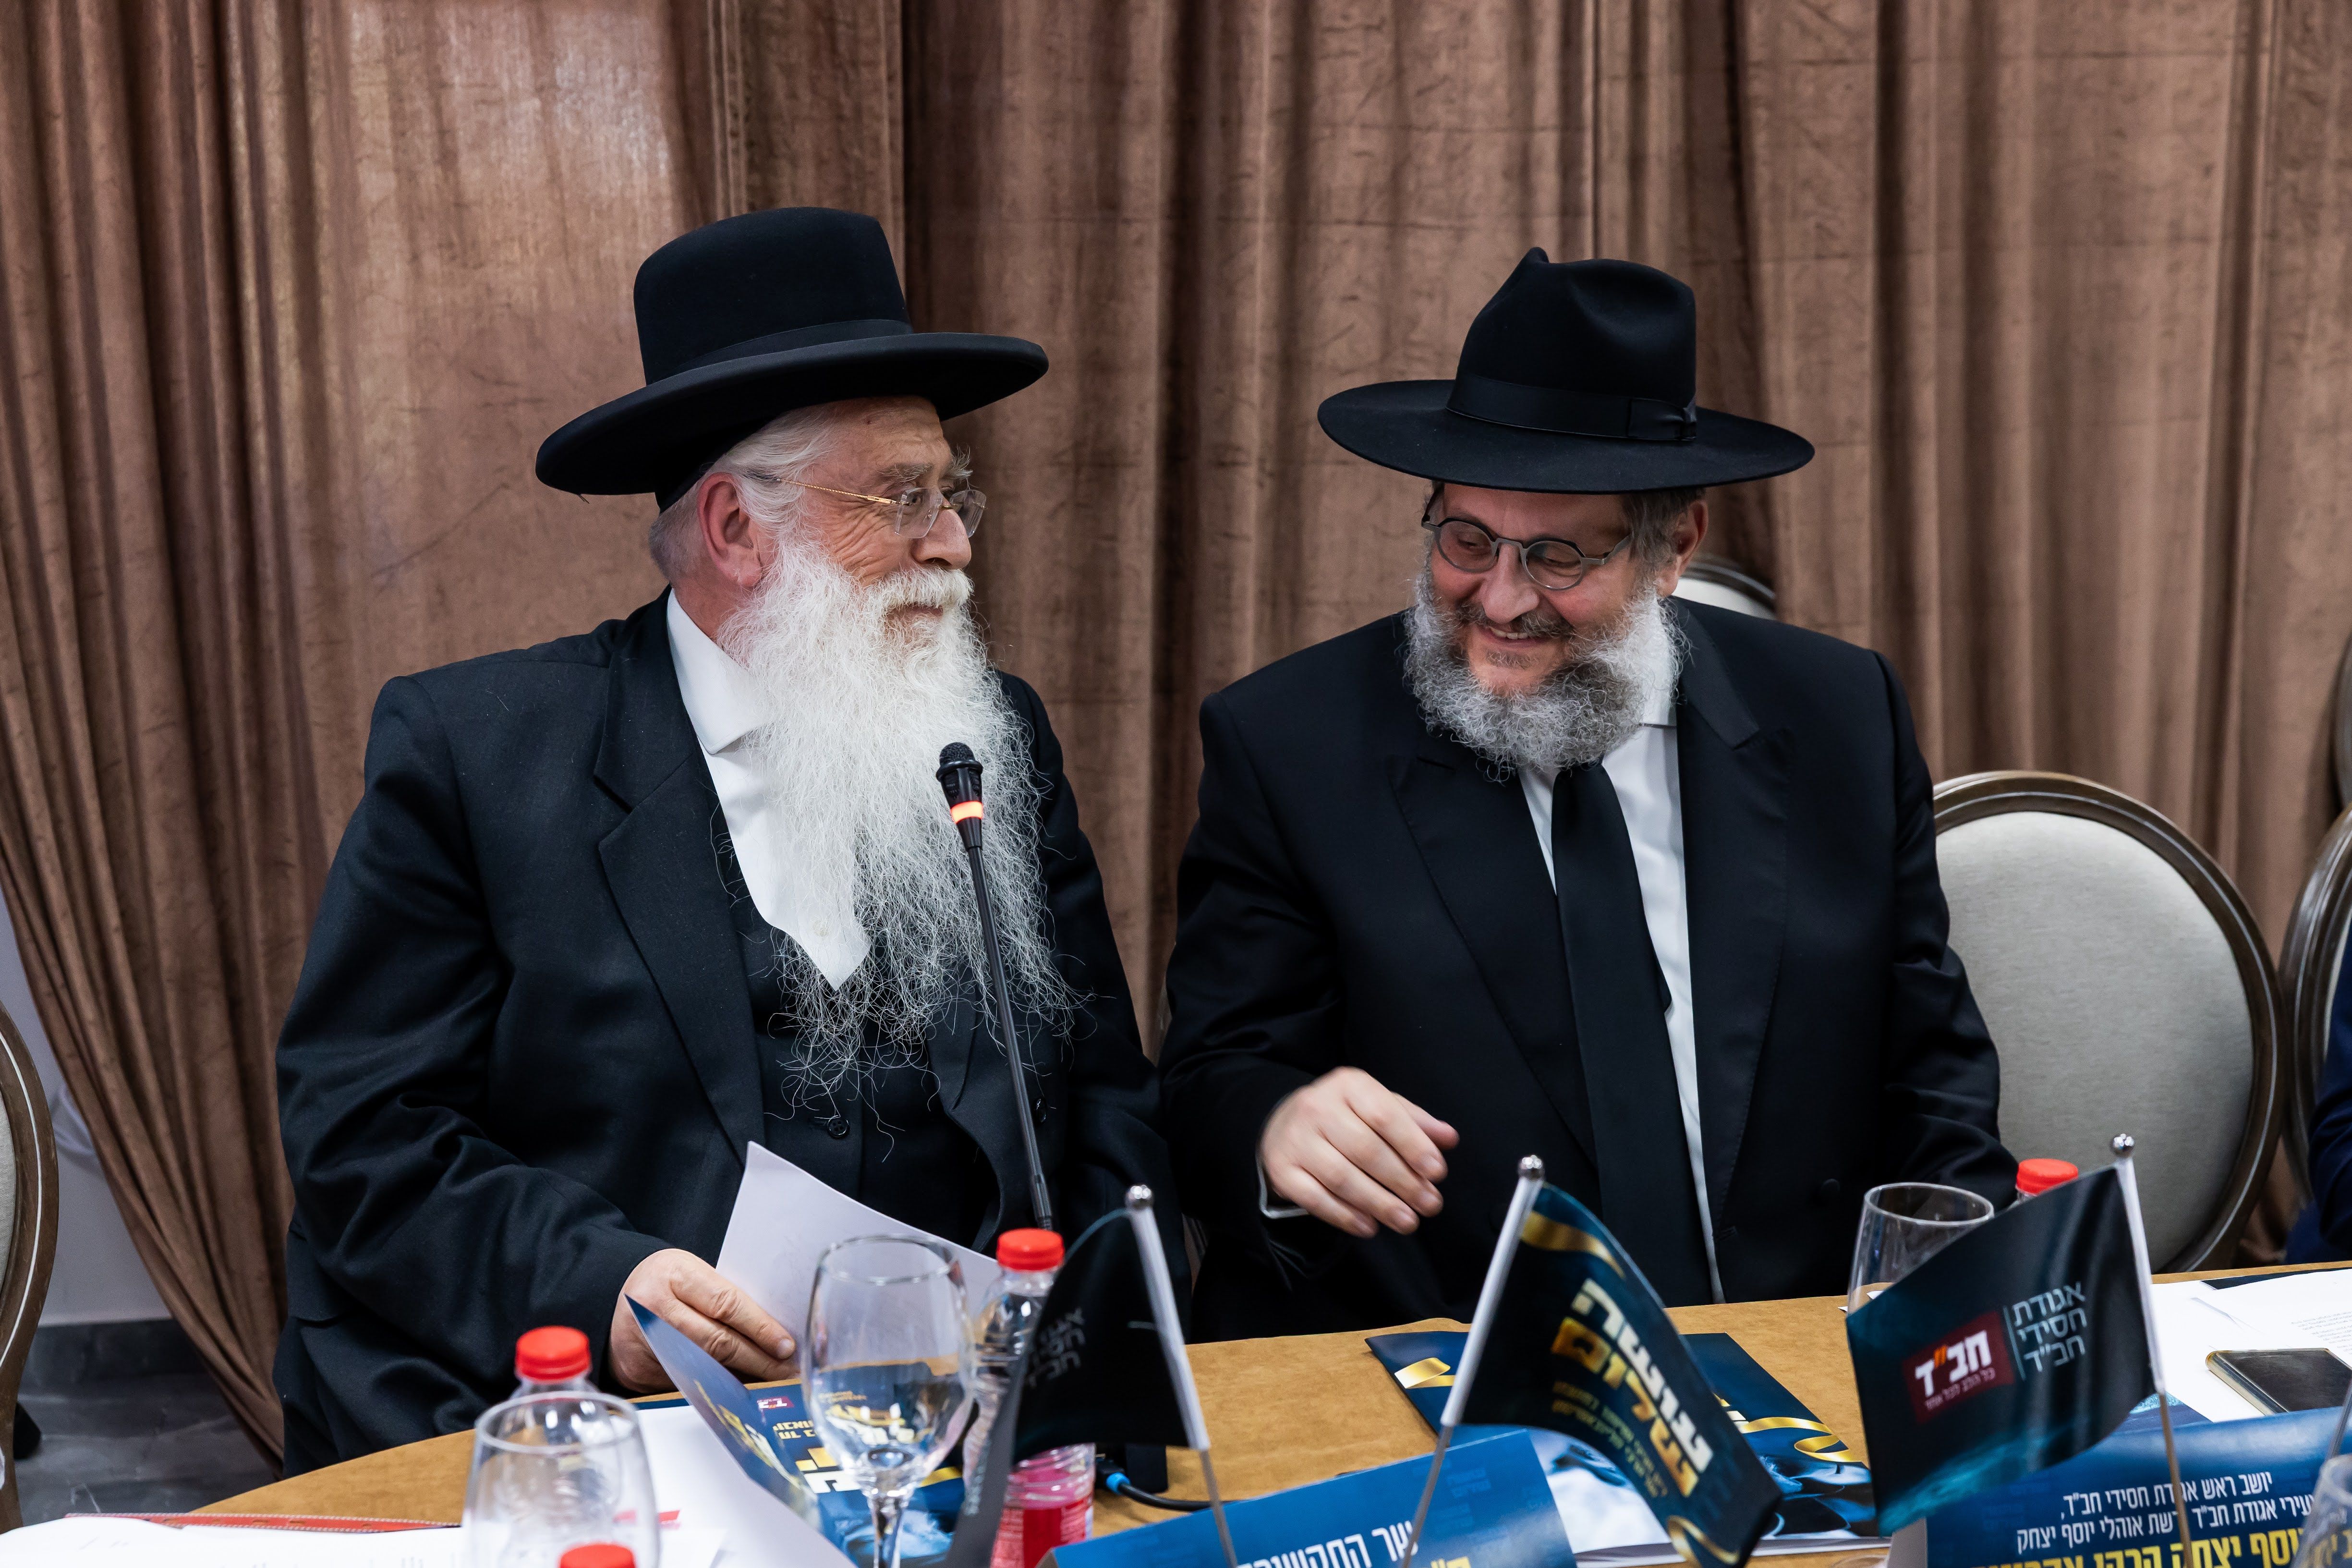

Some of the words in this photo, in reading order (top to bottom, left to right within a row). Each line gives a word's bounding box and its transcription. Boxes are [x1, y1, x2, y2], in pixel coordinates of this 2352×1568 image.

[2012, 1281, 2086, 1327] אגודת
[2017, 1307, 2087, 1345] חסידי
[1915, 1329, 1992, 1397] חב"ד
[2023, 1335, 2086, 1372] חב"ד
[1571, 1277, 1714, 1474] עושה
[1551, 1316, 1699, 1498] שלום
[2154, 1481, 2199, 1506] אגדת
[2201, 1476, 2237, 1500] ראש
[2238, 1471, 2273, 1495] יושב
[2105, 1486, 2150, 1510] חסידי
[2233, 1498, 2278, 1525] אגודת
[2279, 1494, 2315, 1517] עירי
[2099, 1515, 2145, 1540] אוהלי
[2191, 1504, 2230, 1529] חב"ד
[2017, 1526, 2056, 1555] יצחק
[2061, 1521, 2096, 1549] יוסף
[2249, 1528, 2304, 1568] וסף
